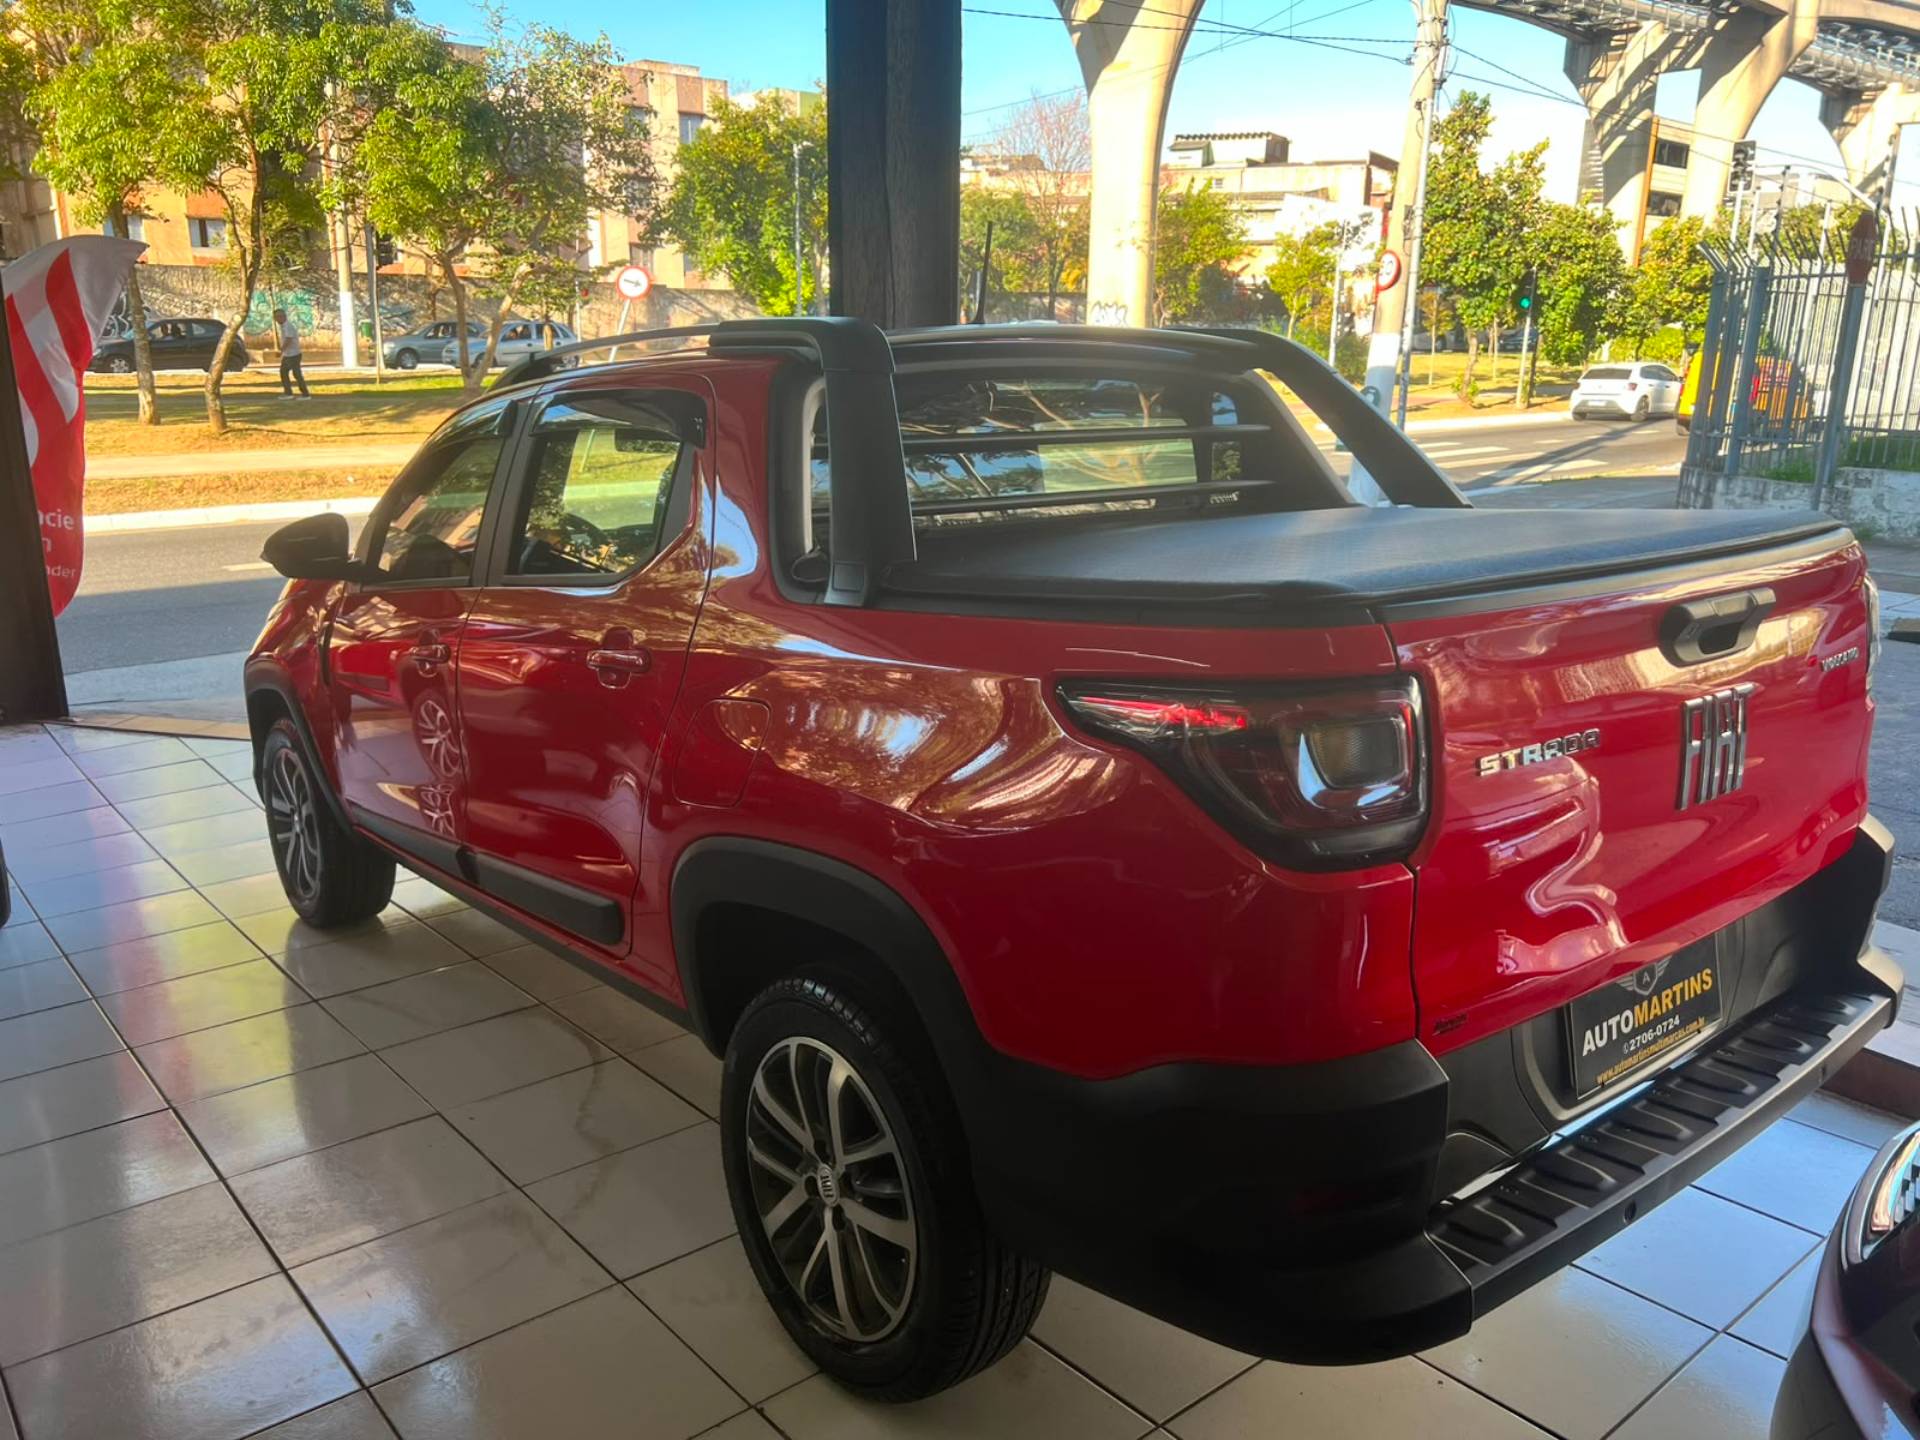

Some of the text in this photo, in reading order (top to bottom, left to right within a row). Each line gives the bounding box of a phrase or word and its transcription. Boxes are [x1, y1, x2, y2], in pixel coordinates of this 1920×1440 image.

[1477, 728, 1600, 776] STRADA
[1582, 967, 1713, 1057] AUTOMARTINS
[1629, 1014, 1680, 1051] 2706-0724
